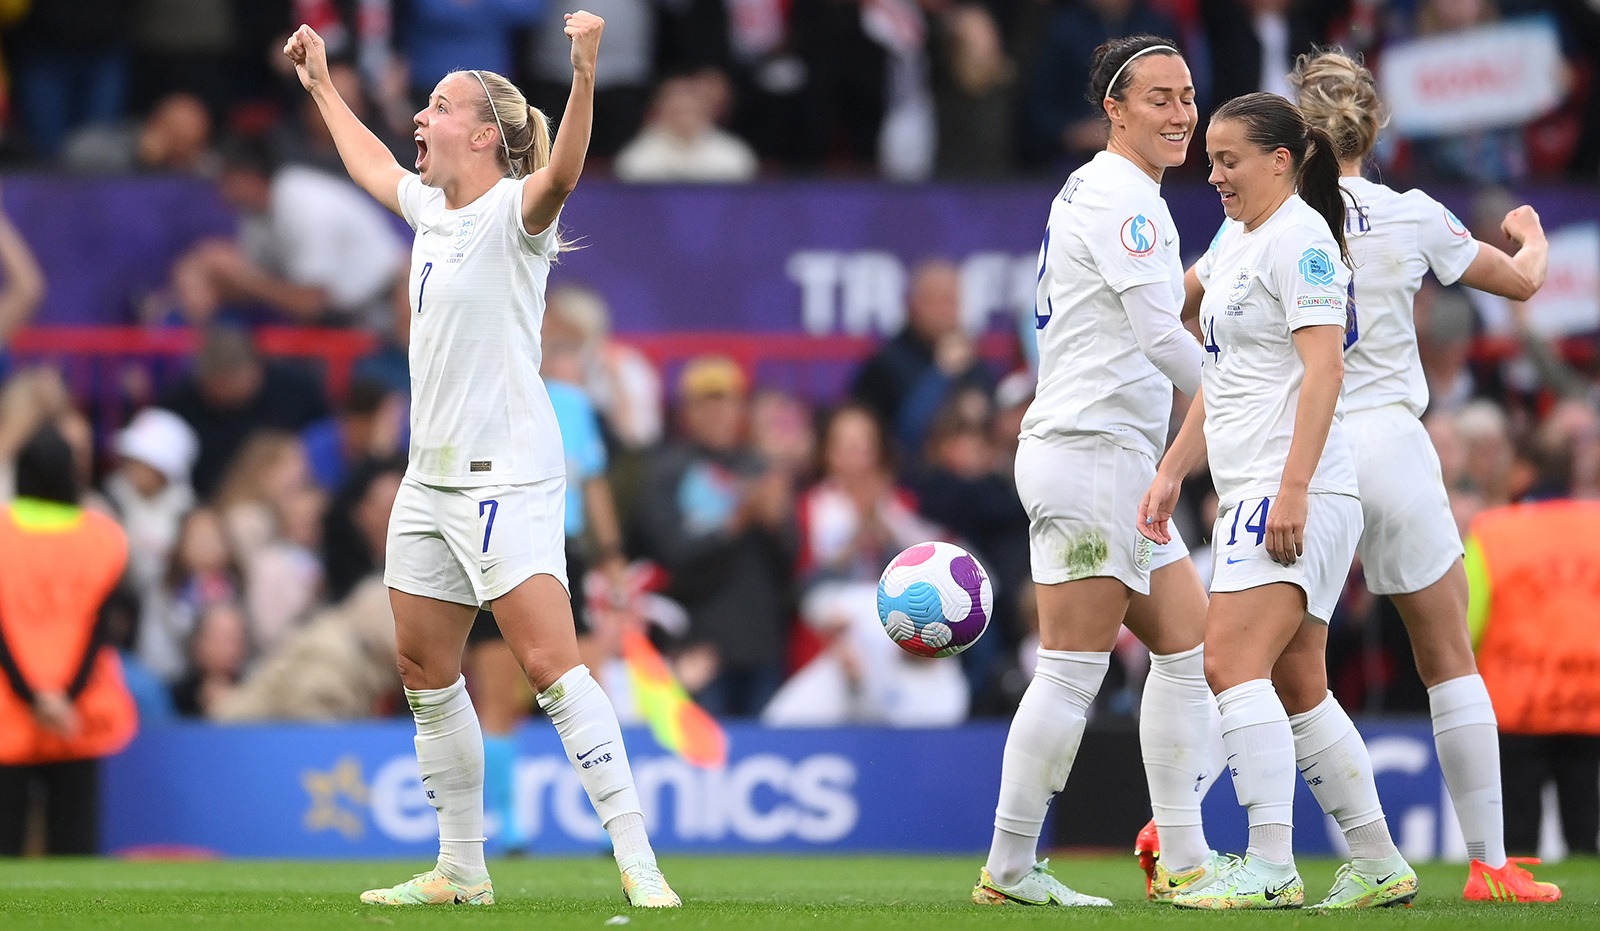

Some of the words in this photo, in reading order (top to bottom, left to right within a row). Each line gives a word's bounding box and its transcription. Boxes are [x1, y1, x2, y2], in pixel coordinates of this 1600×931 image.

[1058, 174, 1084, 204] NZE
[1346, 205, 1371, 233] TE
[418, 262, 432, 313] 7
[1297, 298, 1343, 306] FOUNDATION
[479, 499, 499, 553] 7
[1226, 496, 1270, 547] 14
[581, 752, 613, 769] Eng
[373, 757, 858, 844] eronics
